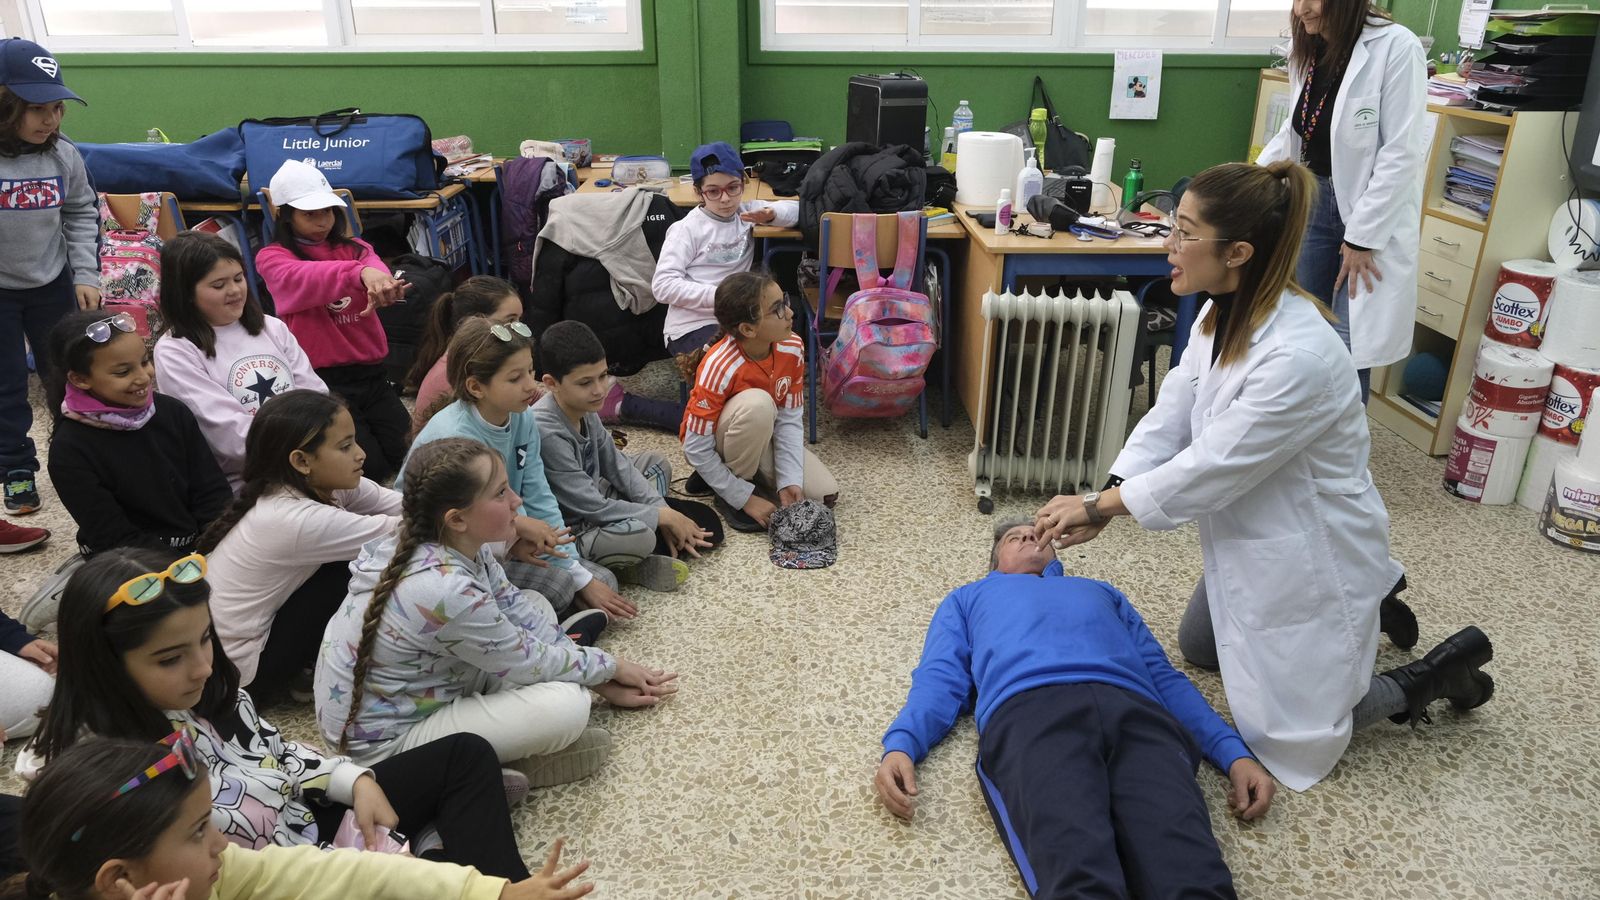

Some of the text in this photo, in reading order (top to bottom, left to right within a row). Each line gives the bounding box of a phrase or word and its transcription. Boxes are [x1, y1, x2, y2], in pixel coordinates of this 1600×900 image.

[283, 137, 370, 151] Little Junior
[1494, 297, 1536, 318] Scottex
[335, 314, 359, 324] NNIE
[1495, 315, 1523, 328] JUMBO
[234, 359, 280, 387] CONVERSE
